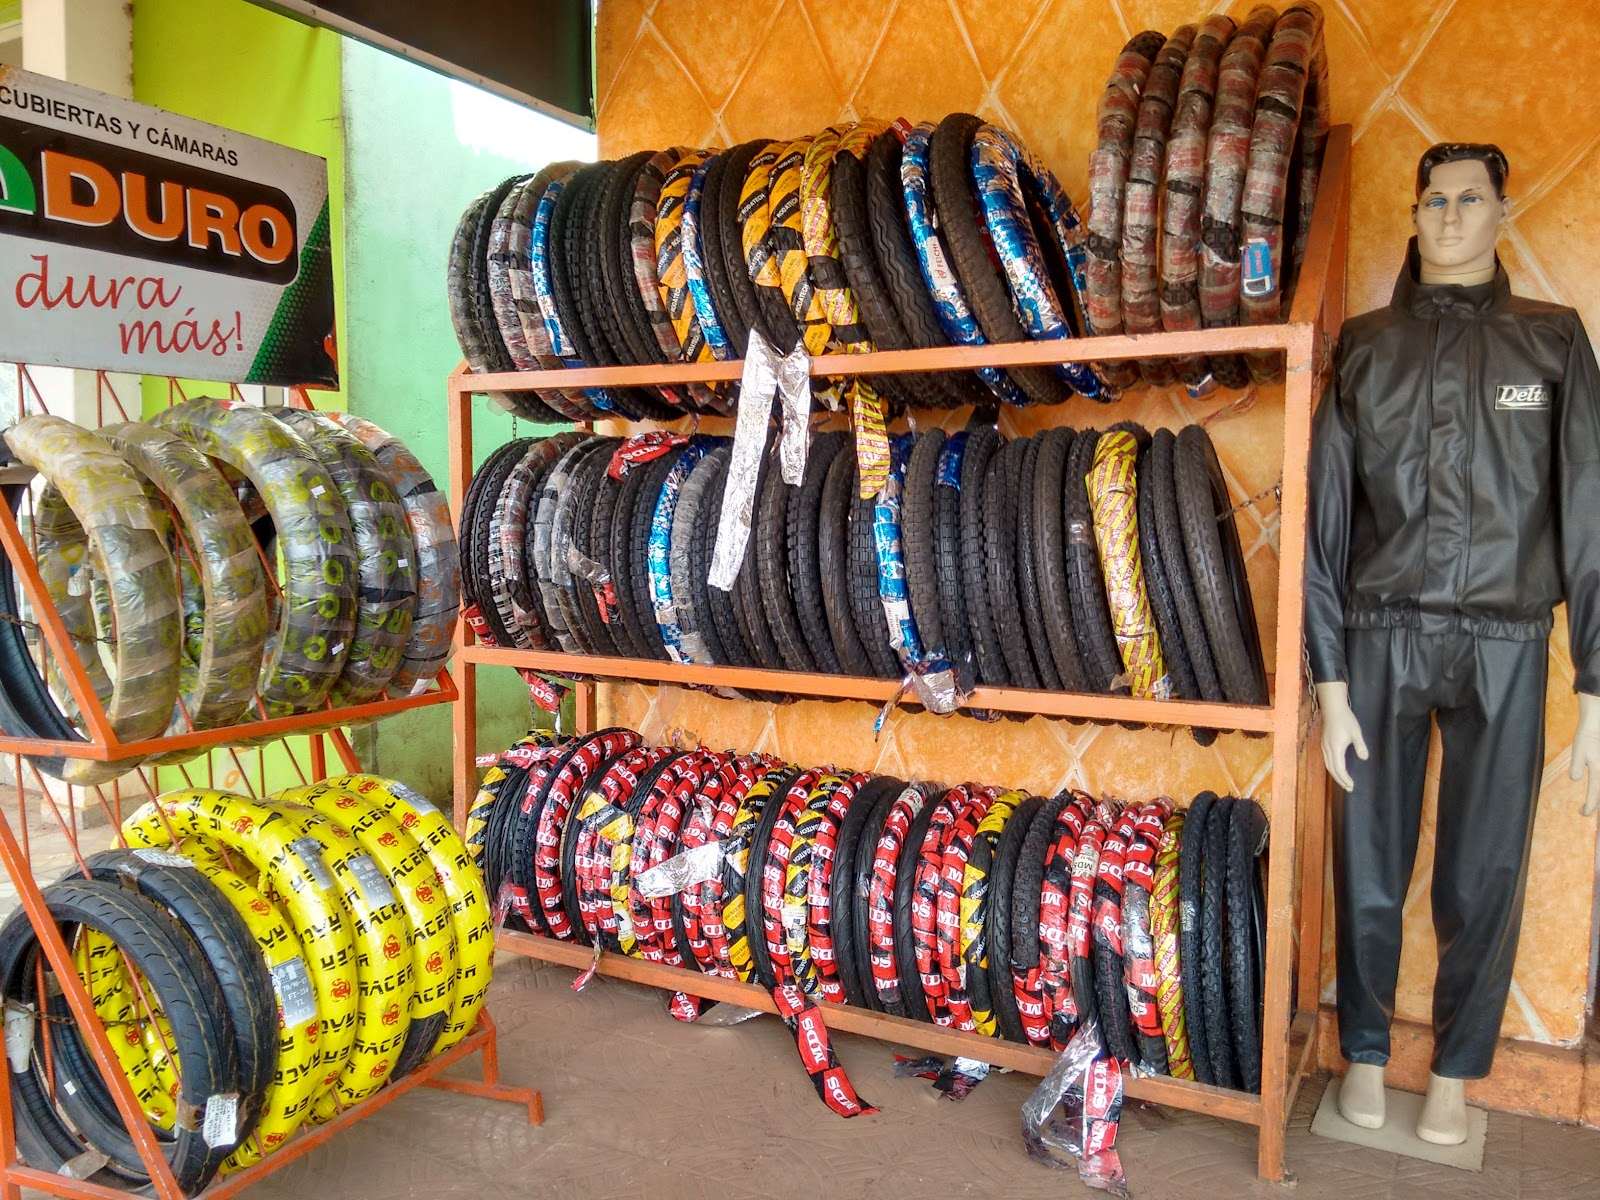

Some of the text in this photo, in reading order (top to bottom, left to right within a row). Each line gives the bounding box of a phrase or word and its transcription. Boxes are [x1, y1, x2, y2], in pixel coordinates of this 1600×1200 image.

[0, 85, 239, 167] CUBIERTAS Y CÁMARAS
[40, 149, 294, 265] DURO
[15, 254, 182, 311] dura
[118, 307, 244, 357] más!
[801, 1017, 827, 1065] MDS
[827, 1075, 856, 1111] MDS
